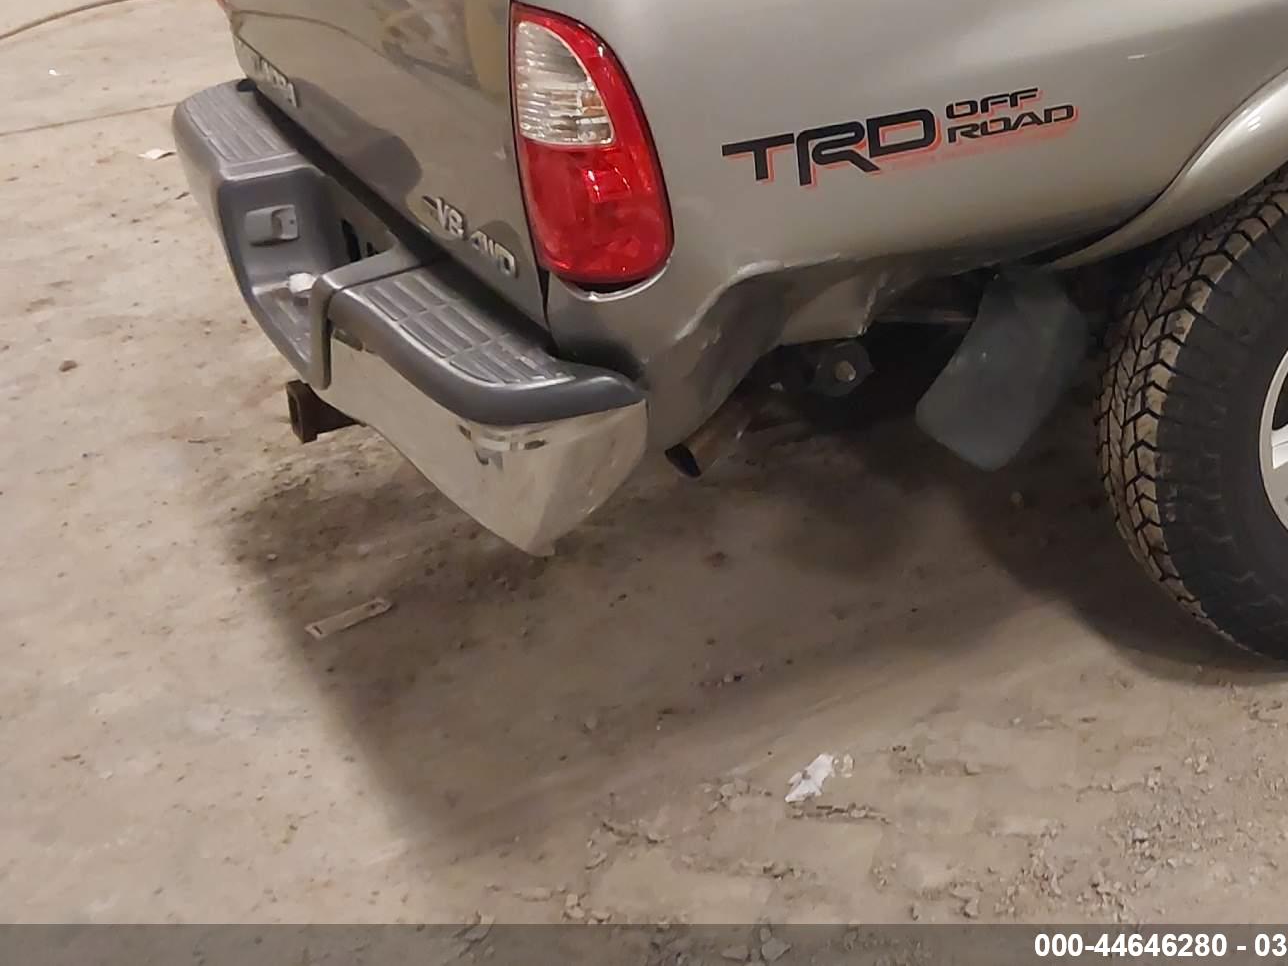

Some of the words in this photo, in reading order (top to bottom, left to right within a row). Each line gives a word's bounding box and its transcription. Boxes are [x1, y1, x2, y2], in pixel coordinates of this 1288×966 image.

[945, 87, 1045, 119] OFF
[946, 104, 1081, 144] ROAD
[721, 108, 942, 187] TRD
[436, 197, 466, 238] V8
